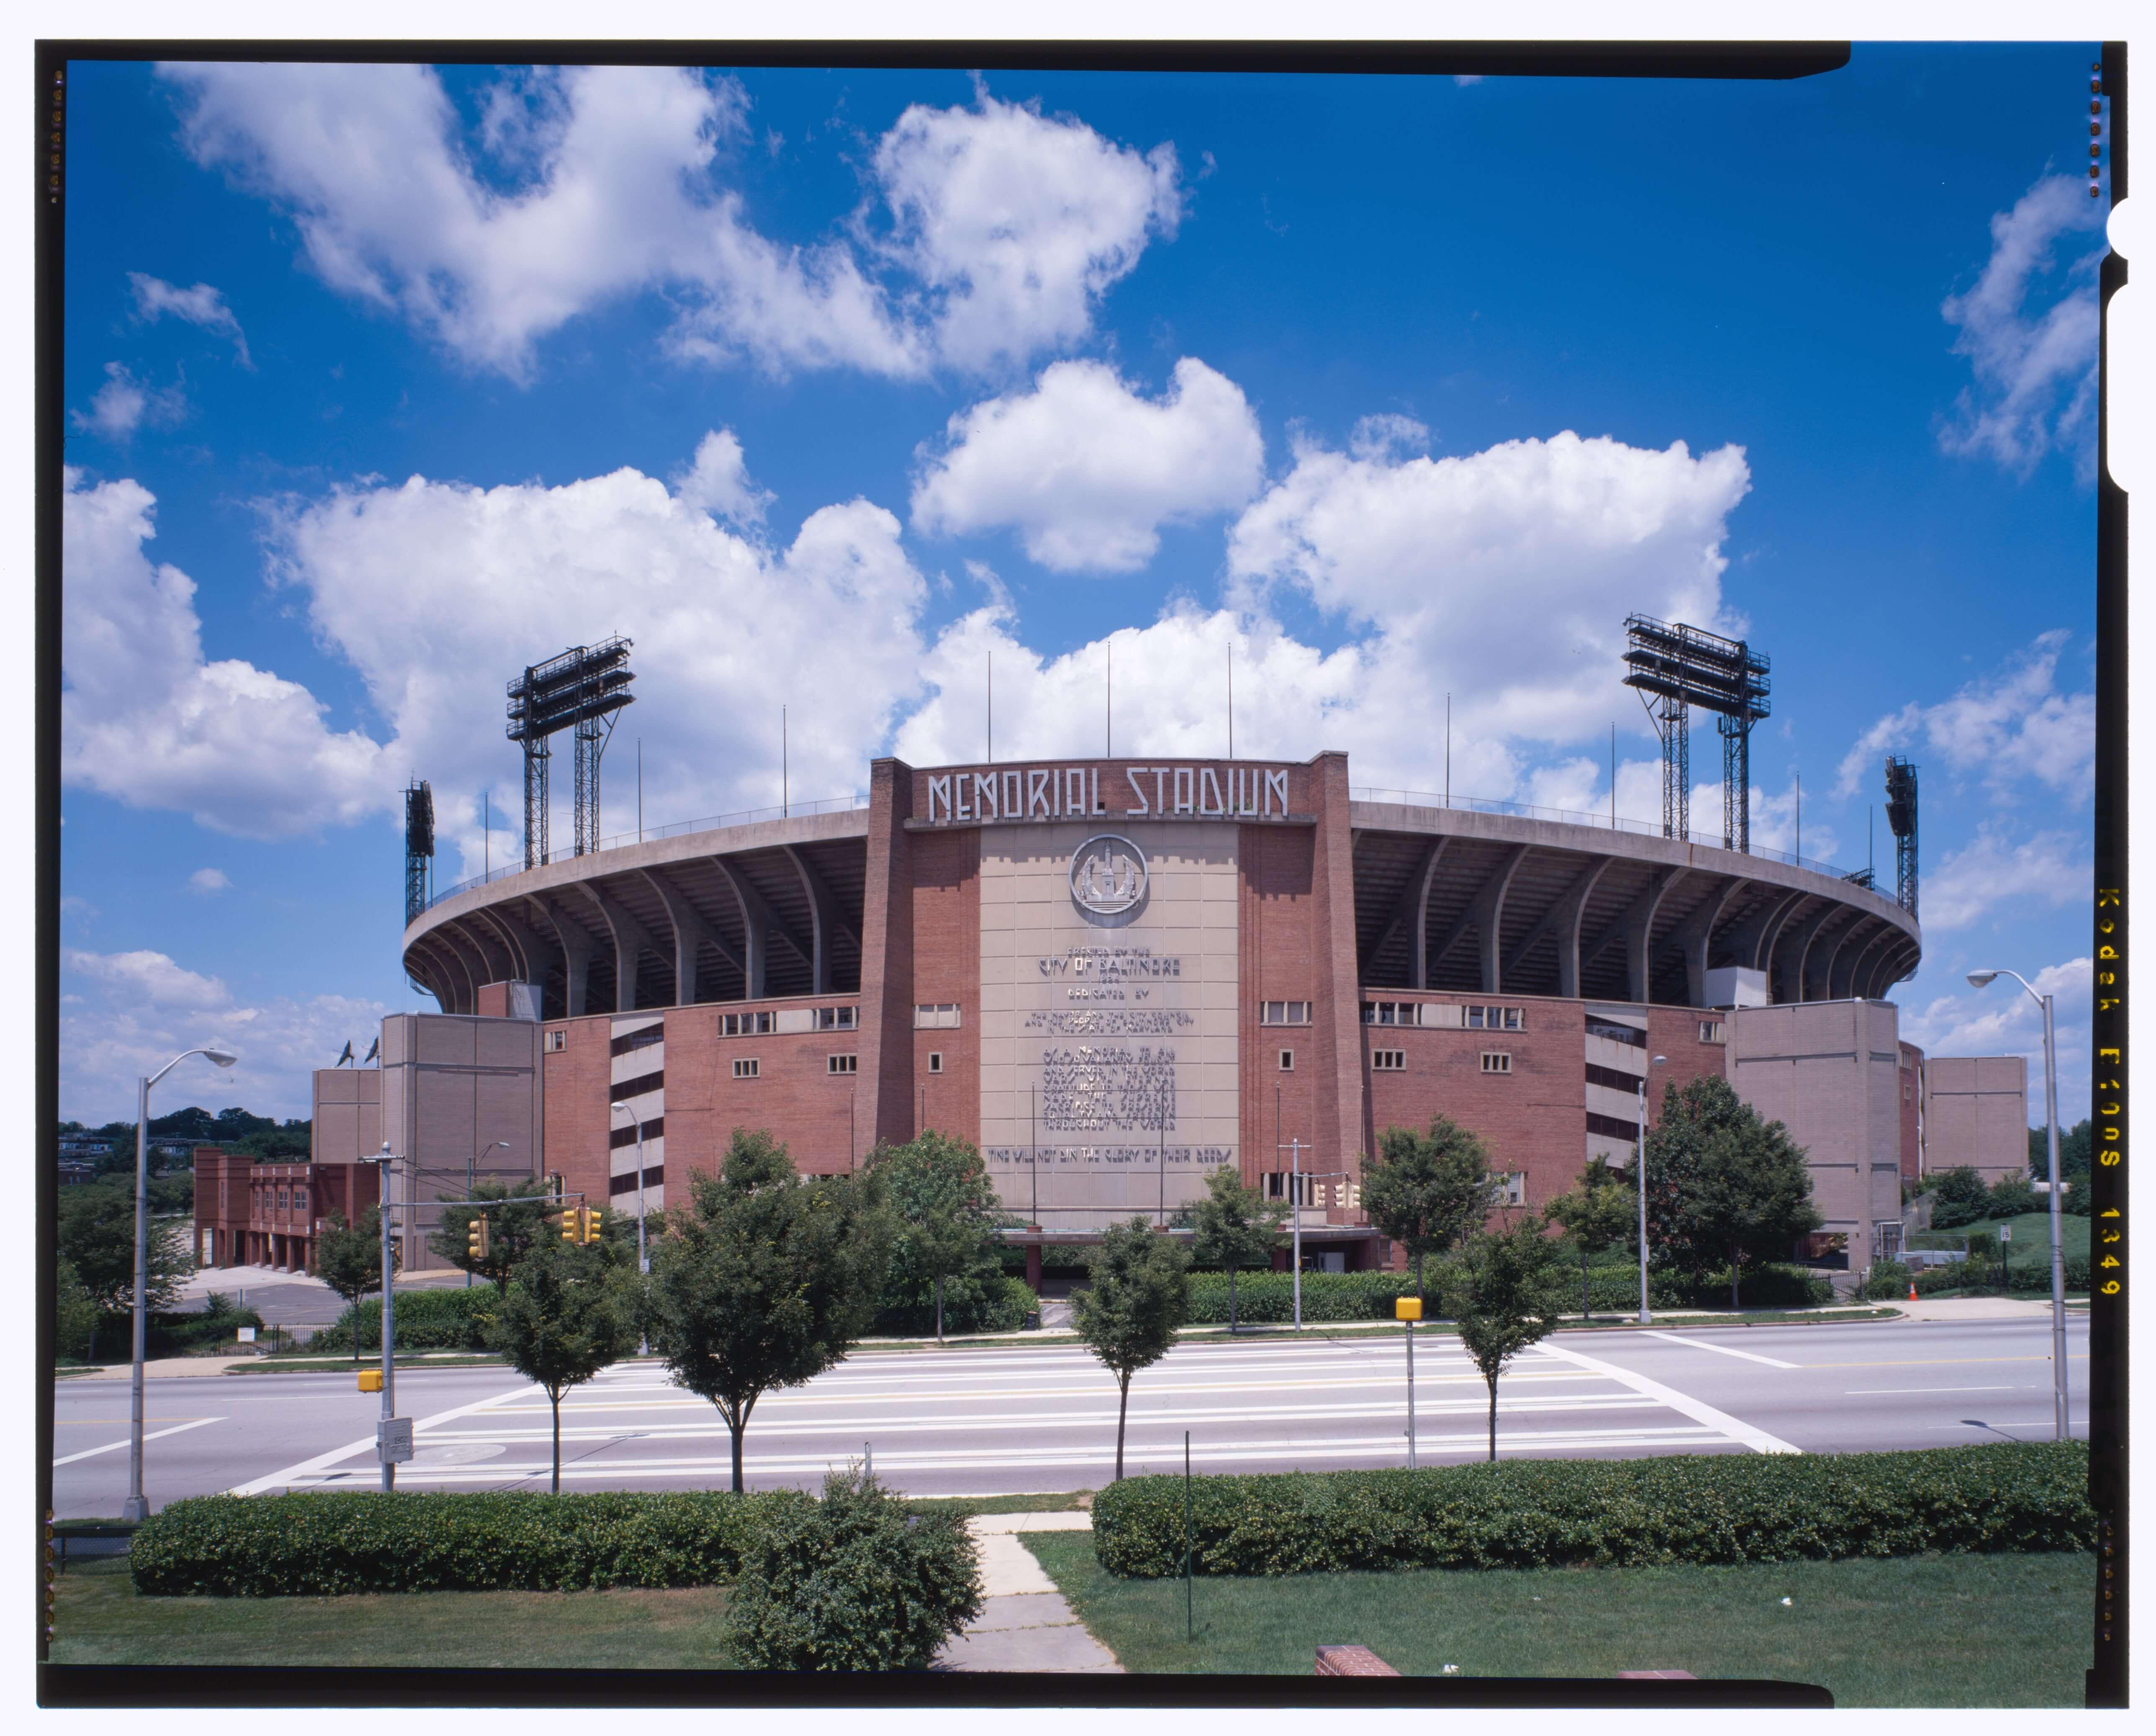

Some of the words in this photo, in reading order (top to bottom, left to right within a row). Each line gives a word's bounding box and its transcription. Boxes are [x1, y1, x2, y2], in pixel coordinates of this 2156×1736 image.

[928, 768, 1106, 822] MEMORIAL
[1127, 767, 1288, 817] STADIUM
[1068, 947, 1109, 956] ERECTED
[1114, 947, 1128, 956] BY
[1132, 947, 1149, 956] THE
[2099, 888, 2120, 1012] Kodak
[1038, 958, 1068, 972] CITY
[1075, 958, 1092, 972] OF
[1099, 958, 1180, 972] BALTIMORE
[1068, 988, 1125, 998] DEDICATED
[1135, 988, 1149, 998] BY
[1044, 1120, 1110, 1128] THROUGHOUT
[1115, 1120, 1133, 1128] THE
[988, 1149, 1009, 1161] TIME
[1012, 1149, 1034, 1161] WILL
[1038, 1149, 1056, 1161] NOT
[1060, 1149, 1077, 1161] DIM
[1081, 1148, 1099, 1160] THE
[1105, 1149, 1139, 1161] GLORY
[1144, 1149, 1157, 1161] OF
[1162, 1149, 1190, 1161] THEIR
[2100, 1208, 2120, 1295] 1349
